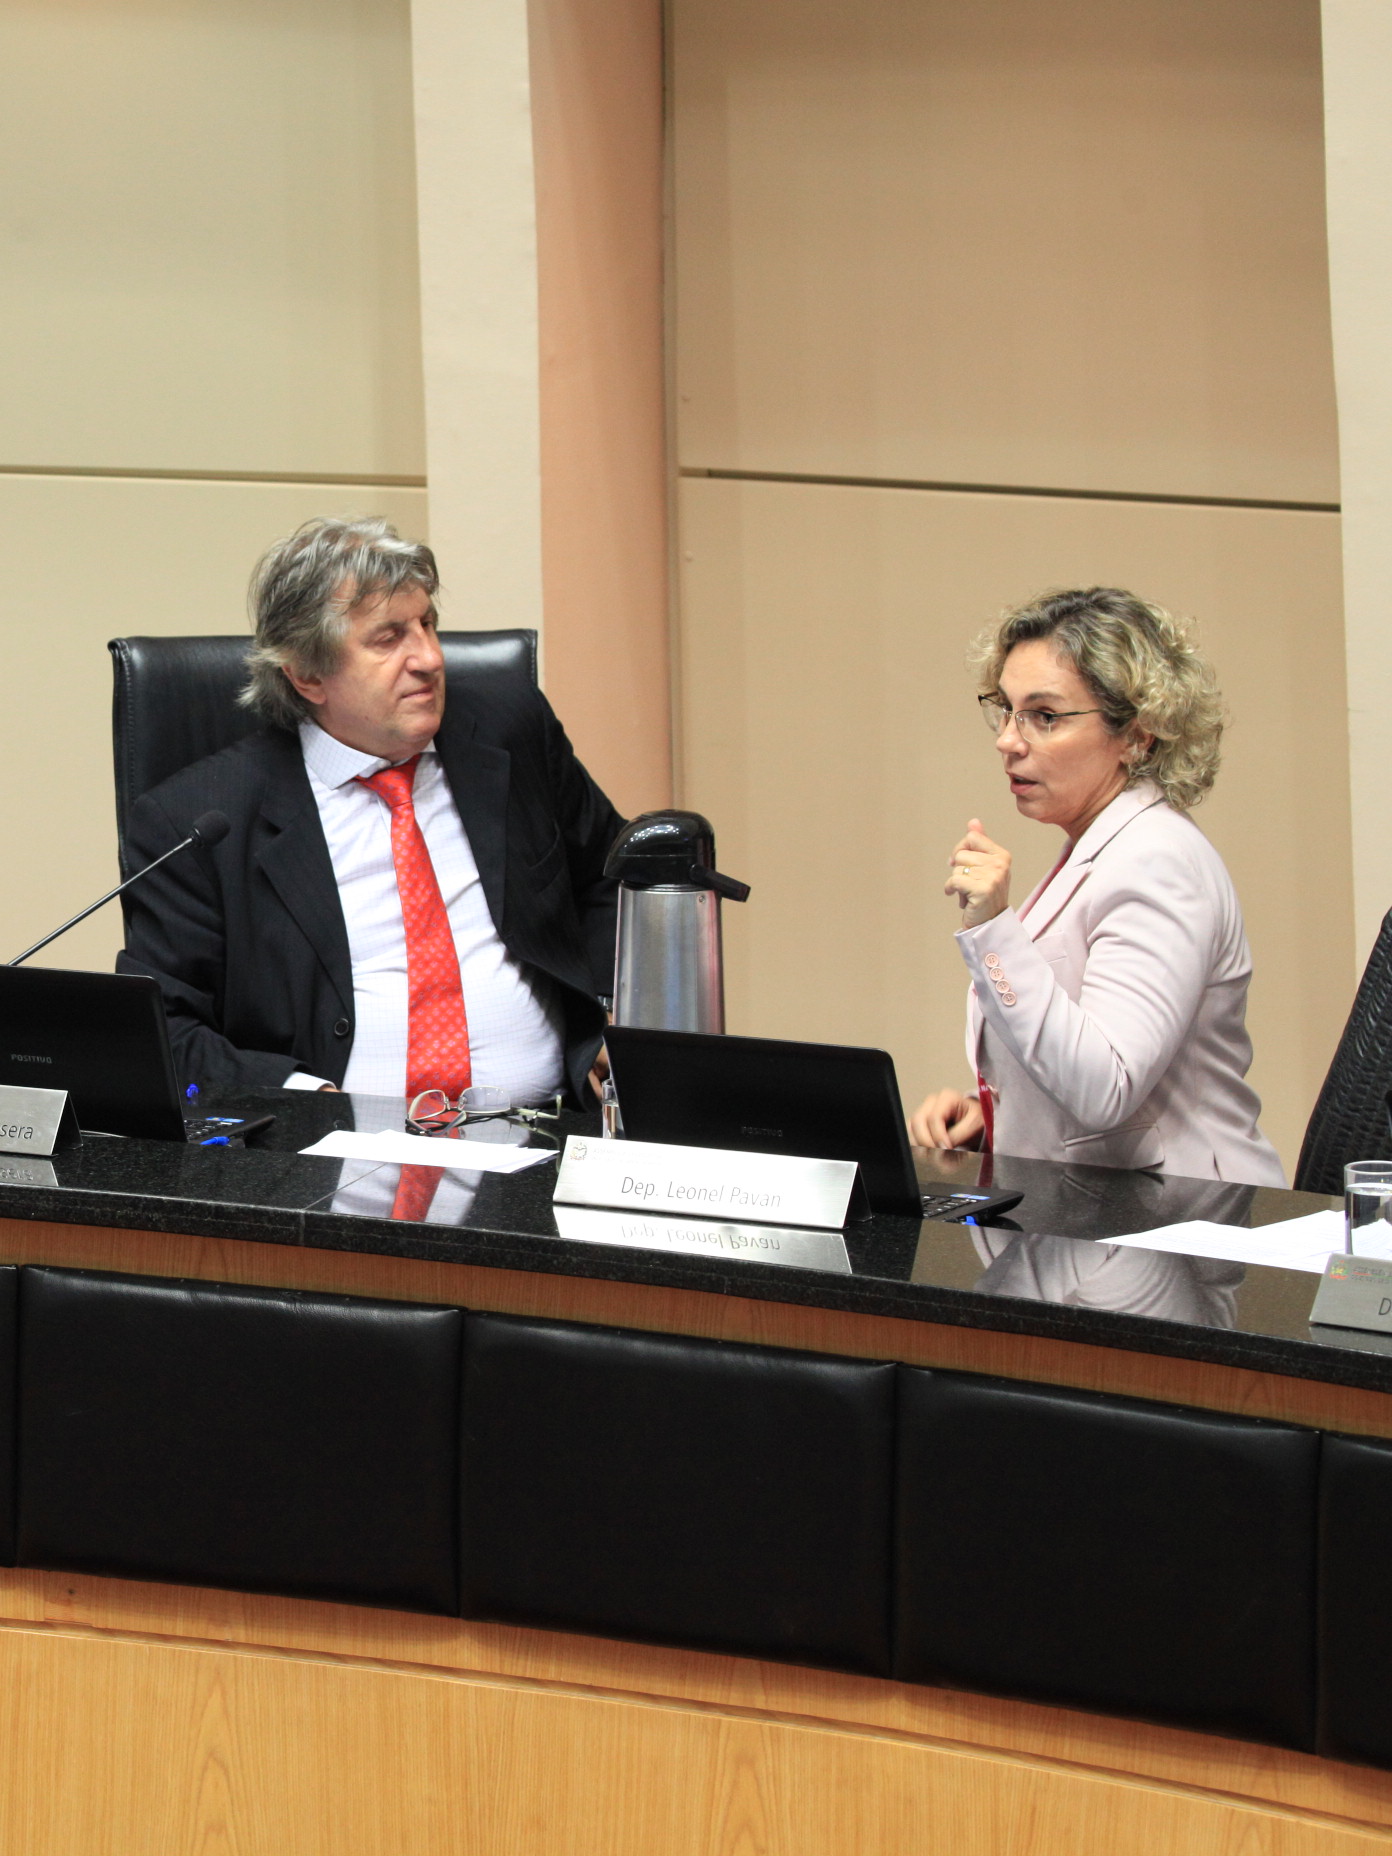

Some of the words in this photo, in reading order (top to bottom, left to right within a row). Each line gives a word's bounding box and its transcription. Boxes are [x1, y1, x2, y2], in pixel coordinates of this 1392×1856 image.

[621, 1176, 659, 1200] Dep.
[667, 1181, 724, 1202] Leonel
[729, 1186, 782, 1208] Pavan
